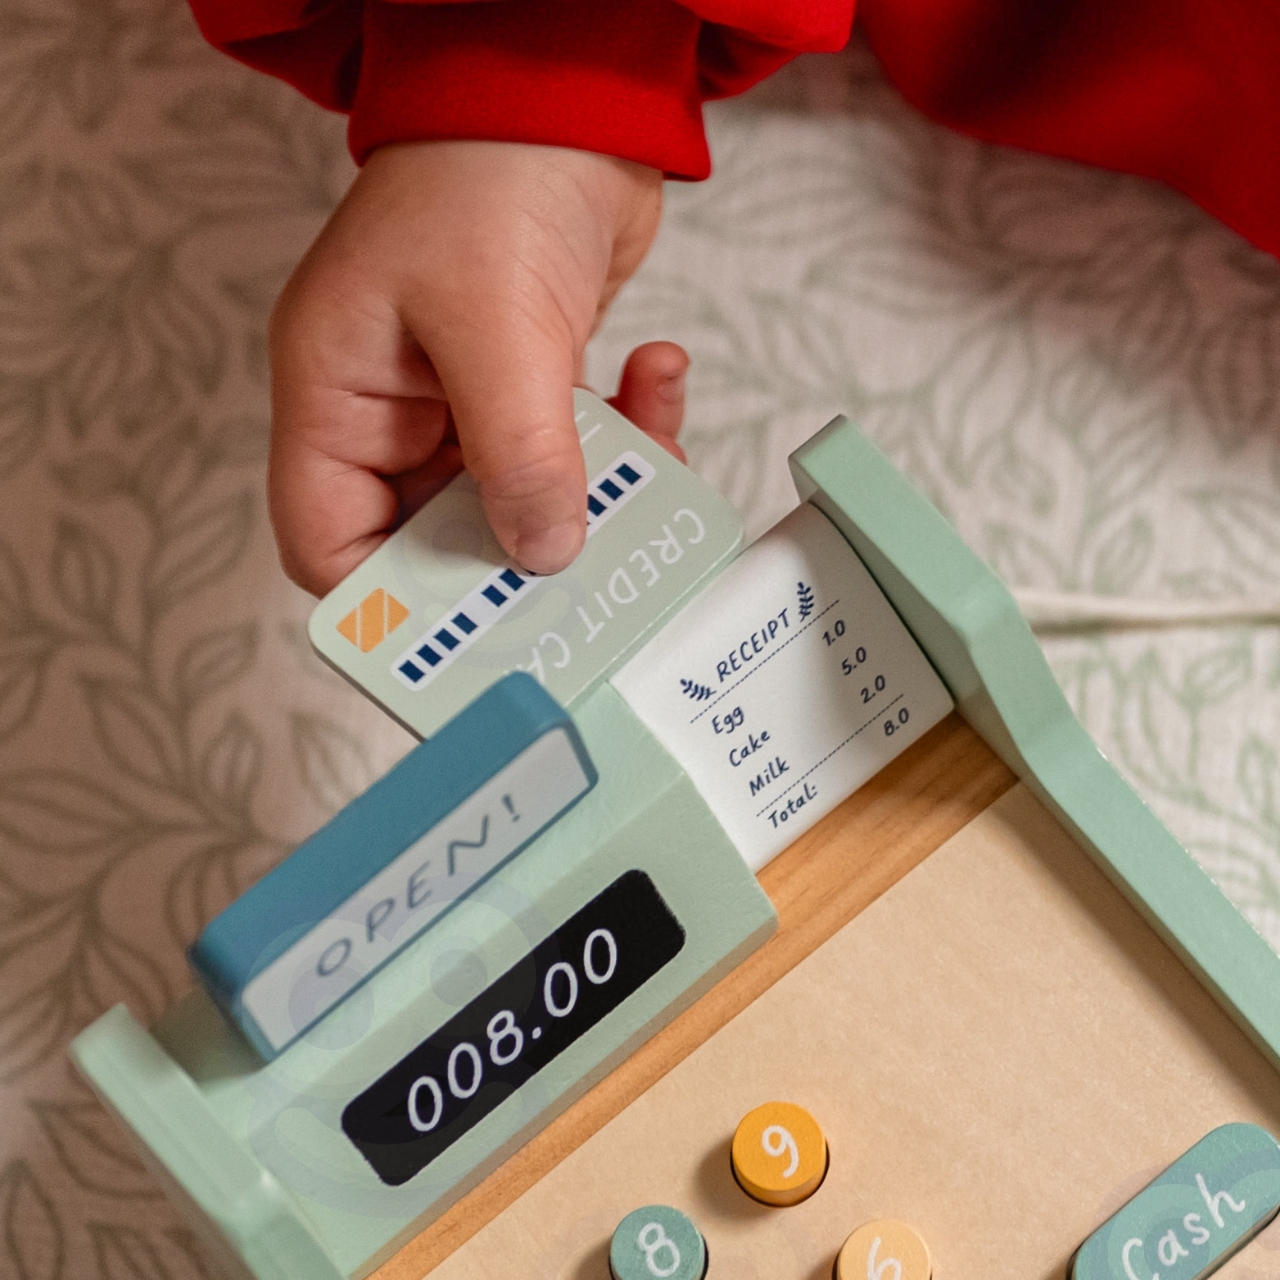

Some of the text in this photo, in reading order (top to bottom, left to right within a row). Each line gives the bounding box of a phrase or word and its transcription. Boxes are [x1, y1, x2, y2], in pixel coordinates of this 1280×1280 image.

[504, 508, 706, 683] CREDIT CA
[715, 607, 791, 684] RECEIPT
[711, 619, 847, 735] Egg 1.0
[728, 646, 868, 768] Cake 5.0
[749, 674, 887, 798] Milk 2.0
[767, 707, 910, 829] Total: 8.0
[315, 793, 521, 979] OPEN!
[407, 927, 619, 1132] 008.00
[635, 1221, 681, 1278] 8
[760, 1124, 800, 1179] 9
